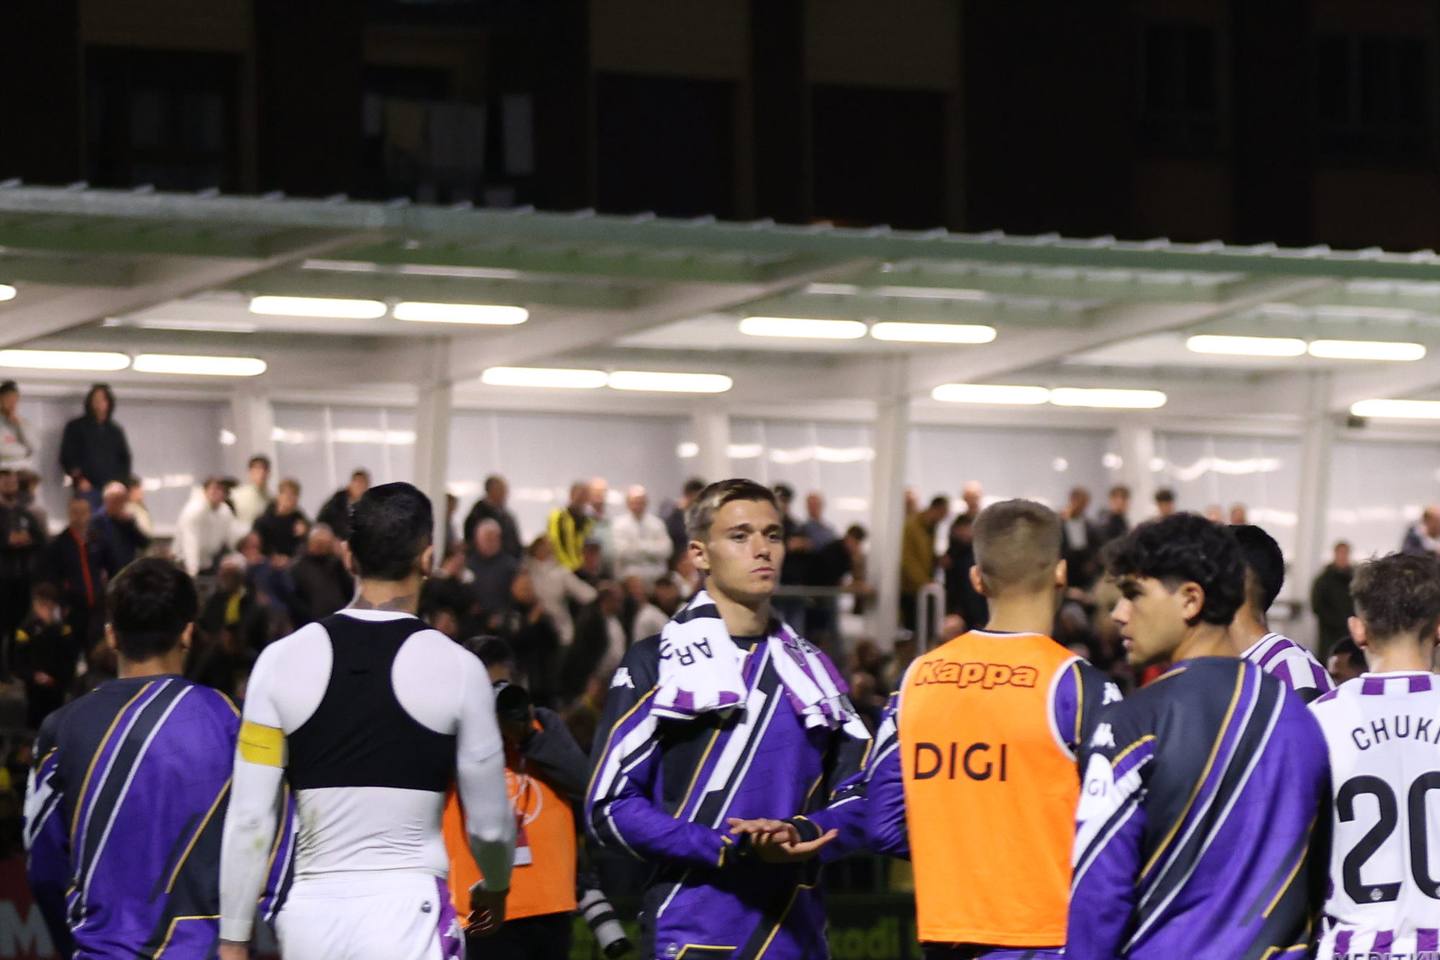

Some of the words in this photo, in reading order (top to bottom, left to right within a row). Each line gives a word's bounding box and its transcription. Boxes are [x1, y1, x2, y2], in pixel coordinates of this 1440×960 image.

[914, 659, 1040, 690] Kappa
[913, 742, 1007, 782] DIGI
[1087, 778, 1107, 797] GI
